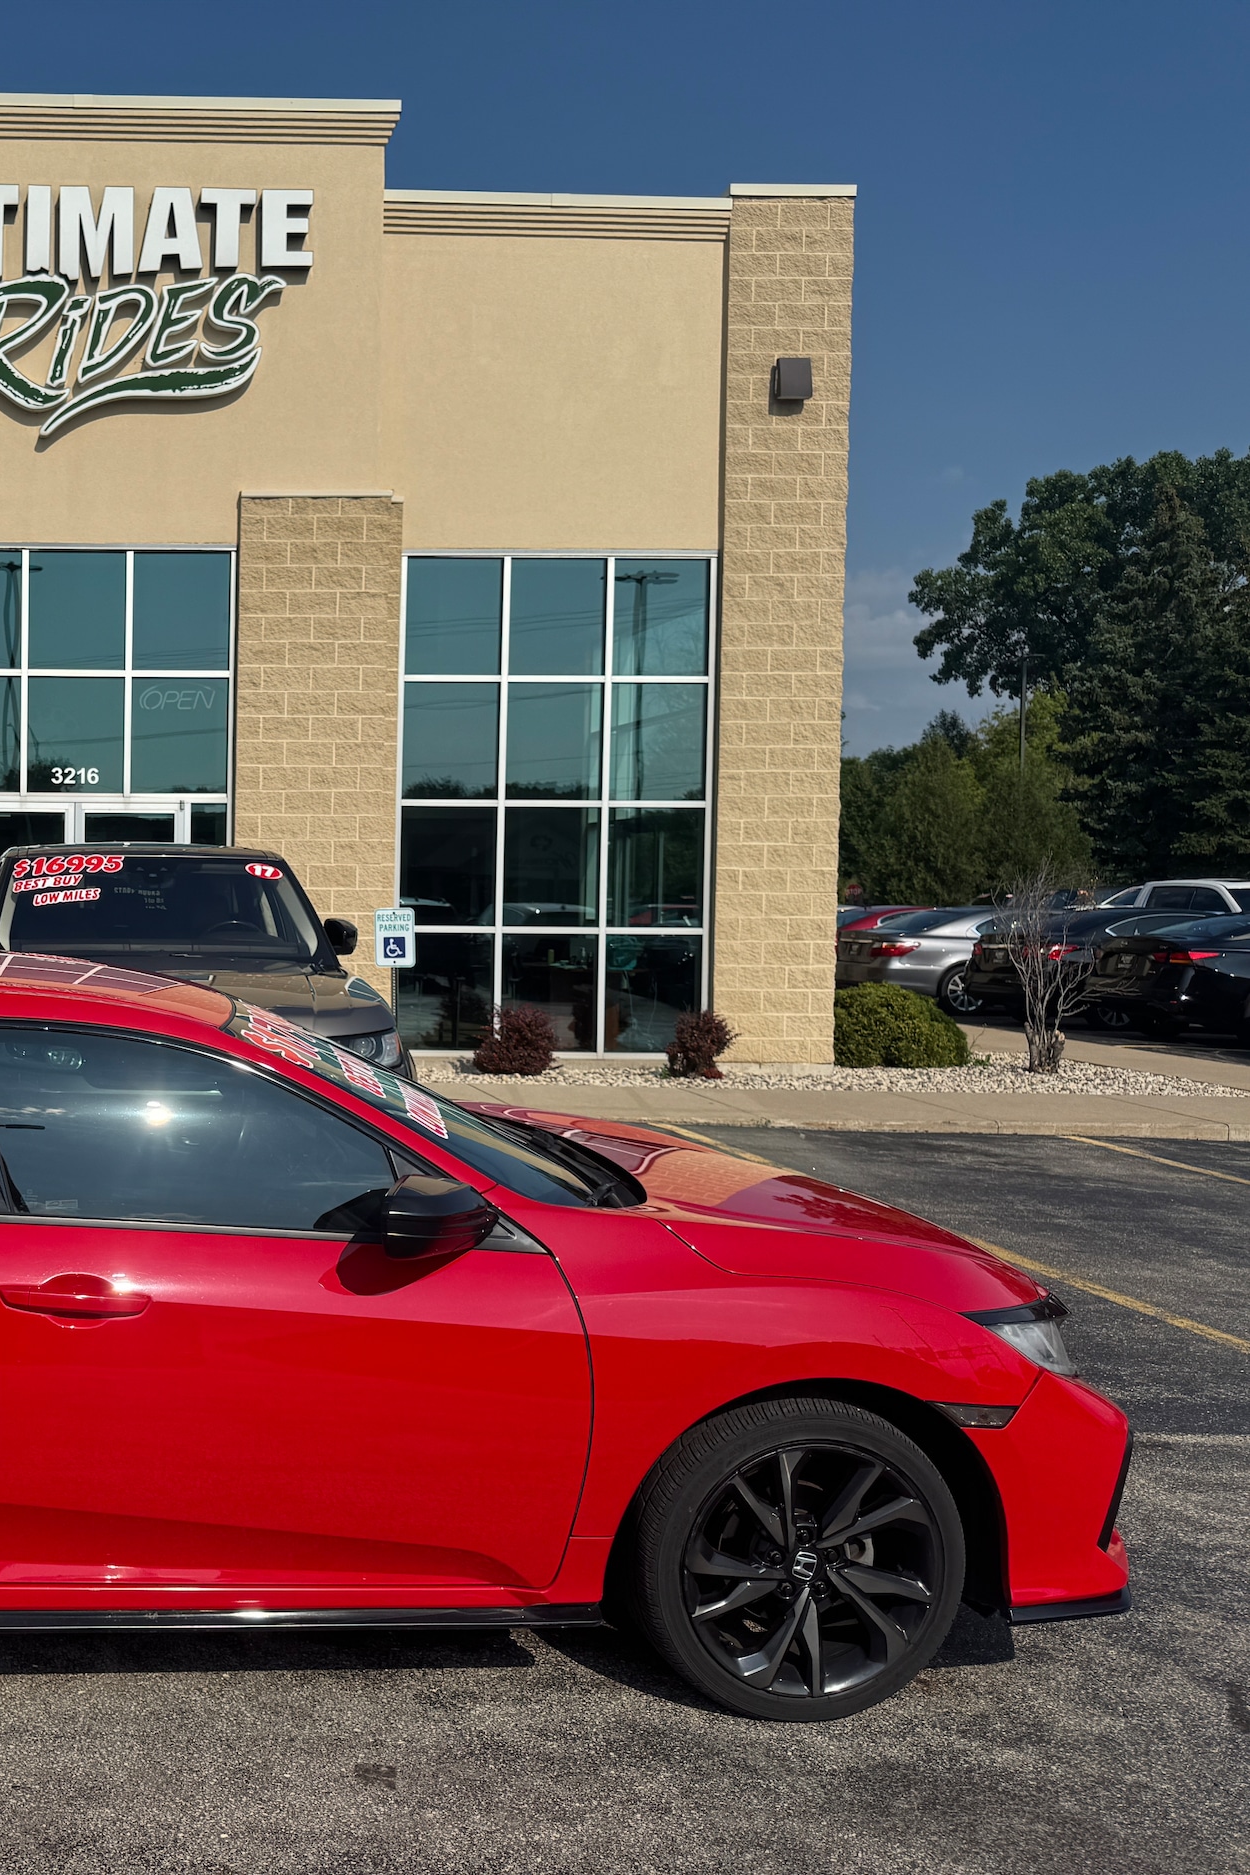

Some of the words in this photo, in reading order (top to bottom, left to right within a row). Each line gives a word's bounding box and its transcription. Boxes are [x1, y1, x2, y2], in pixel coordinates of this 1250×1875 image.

[143, 690, 216, 710] OPEN
[50, 766, 100, 785] 3216
[12, 854, 125, 877] $16995
[252, 865, 275, 878] 17
[13, 877, 49, 893] BEST
[52, 874, 82, 887] BUY
[33, 893, 60, 907] LOW
[62, 887, 101, 902] MILES
[376, 913, 412, 922] RESERVED
[379, 923, 410, 932] PARKING
